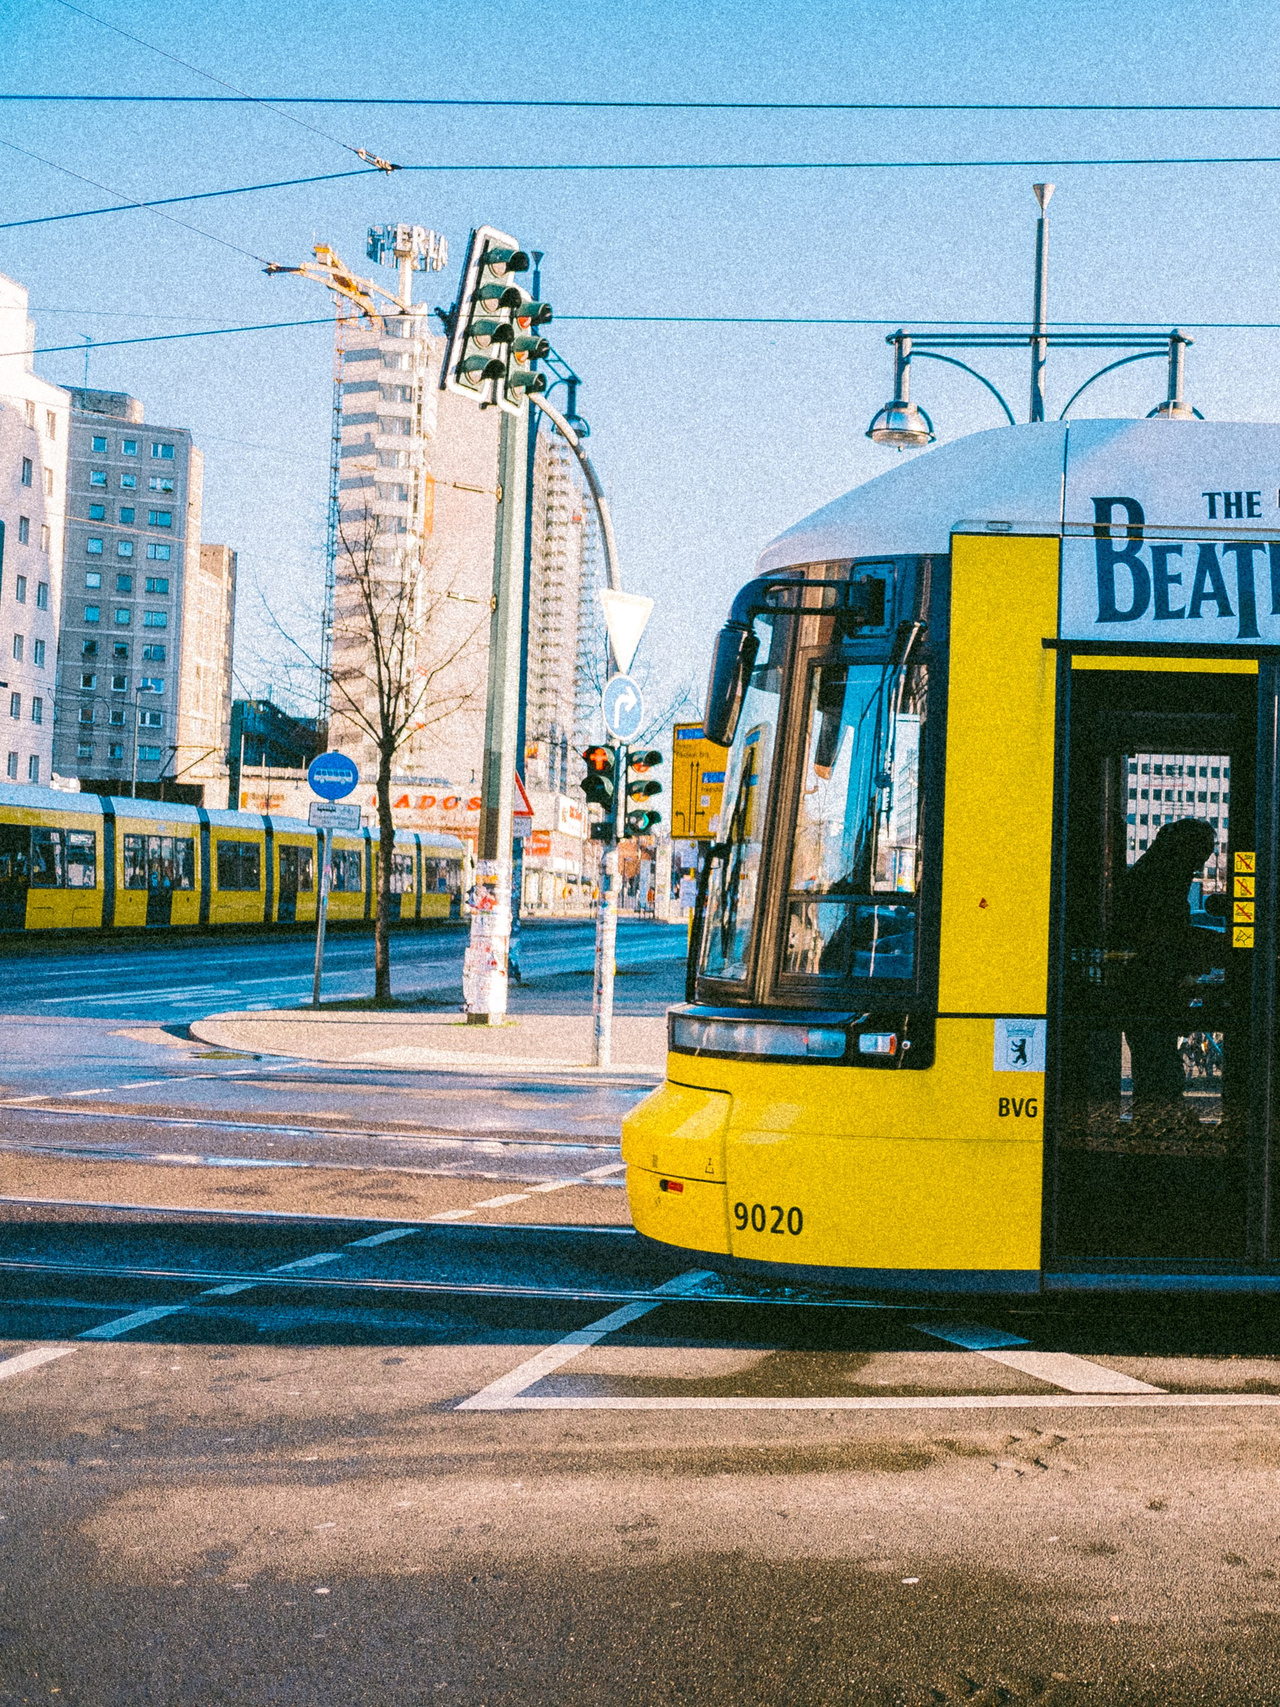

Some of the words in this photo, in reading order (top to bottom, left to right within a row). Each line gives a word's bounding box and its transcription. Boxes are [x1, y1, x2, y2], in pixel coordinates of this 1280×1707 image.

[1202, 490, 1262, 519] THE
[998, 1097, 1038, 1118] BVG
[734, 1202, 803, 1235] 9020
